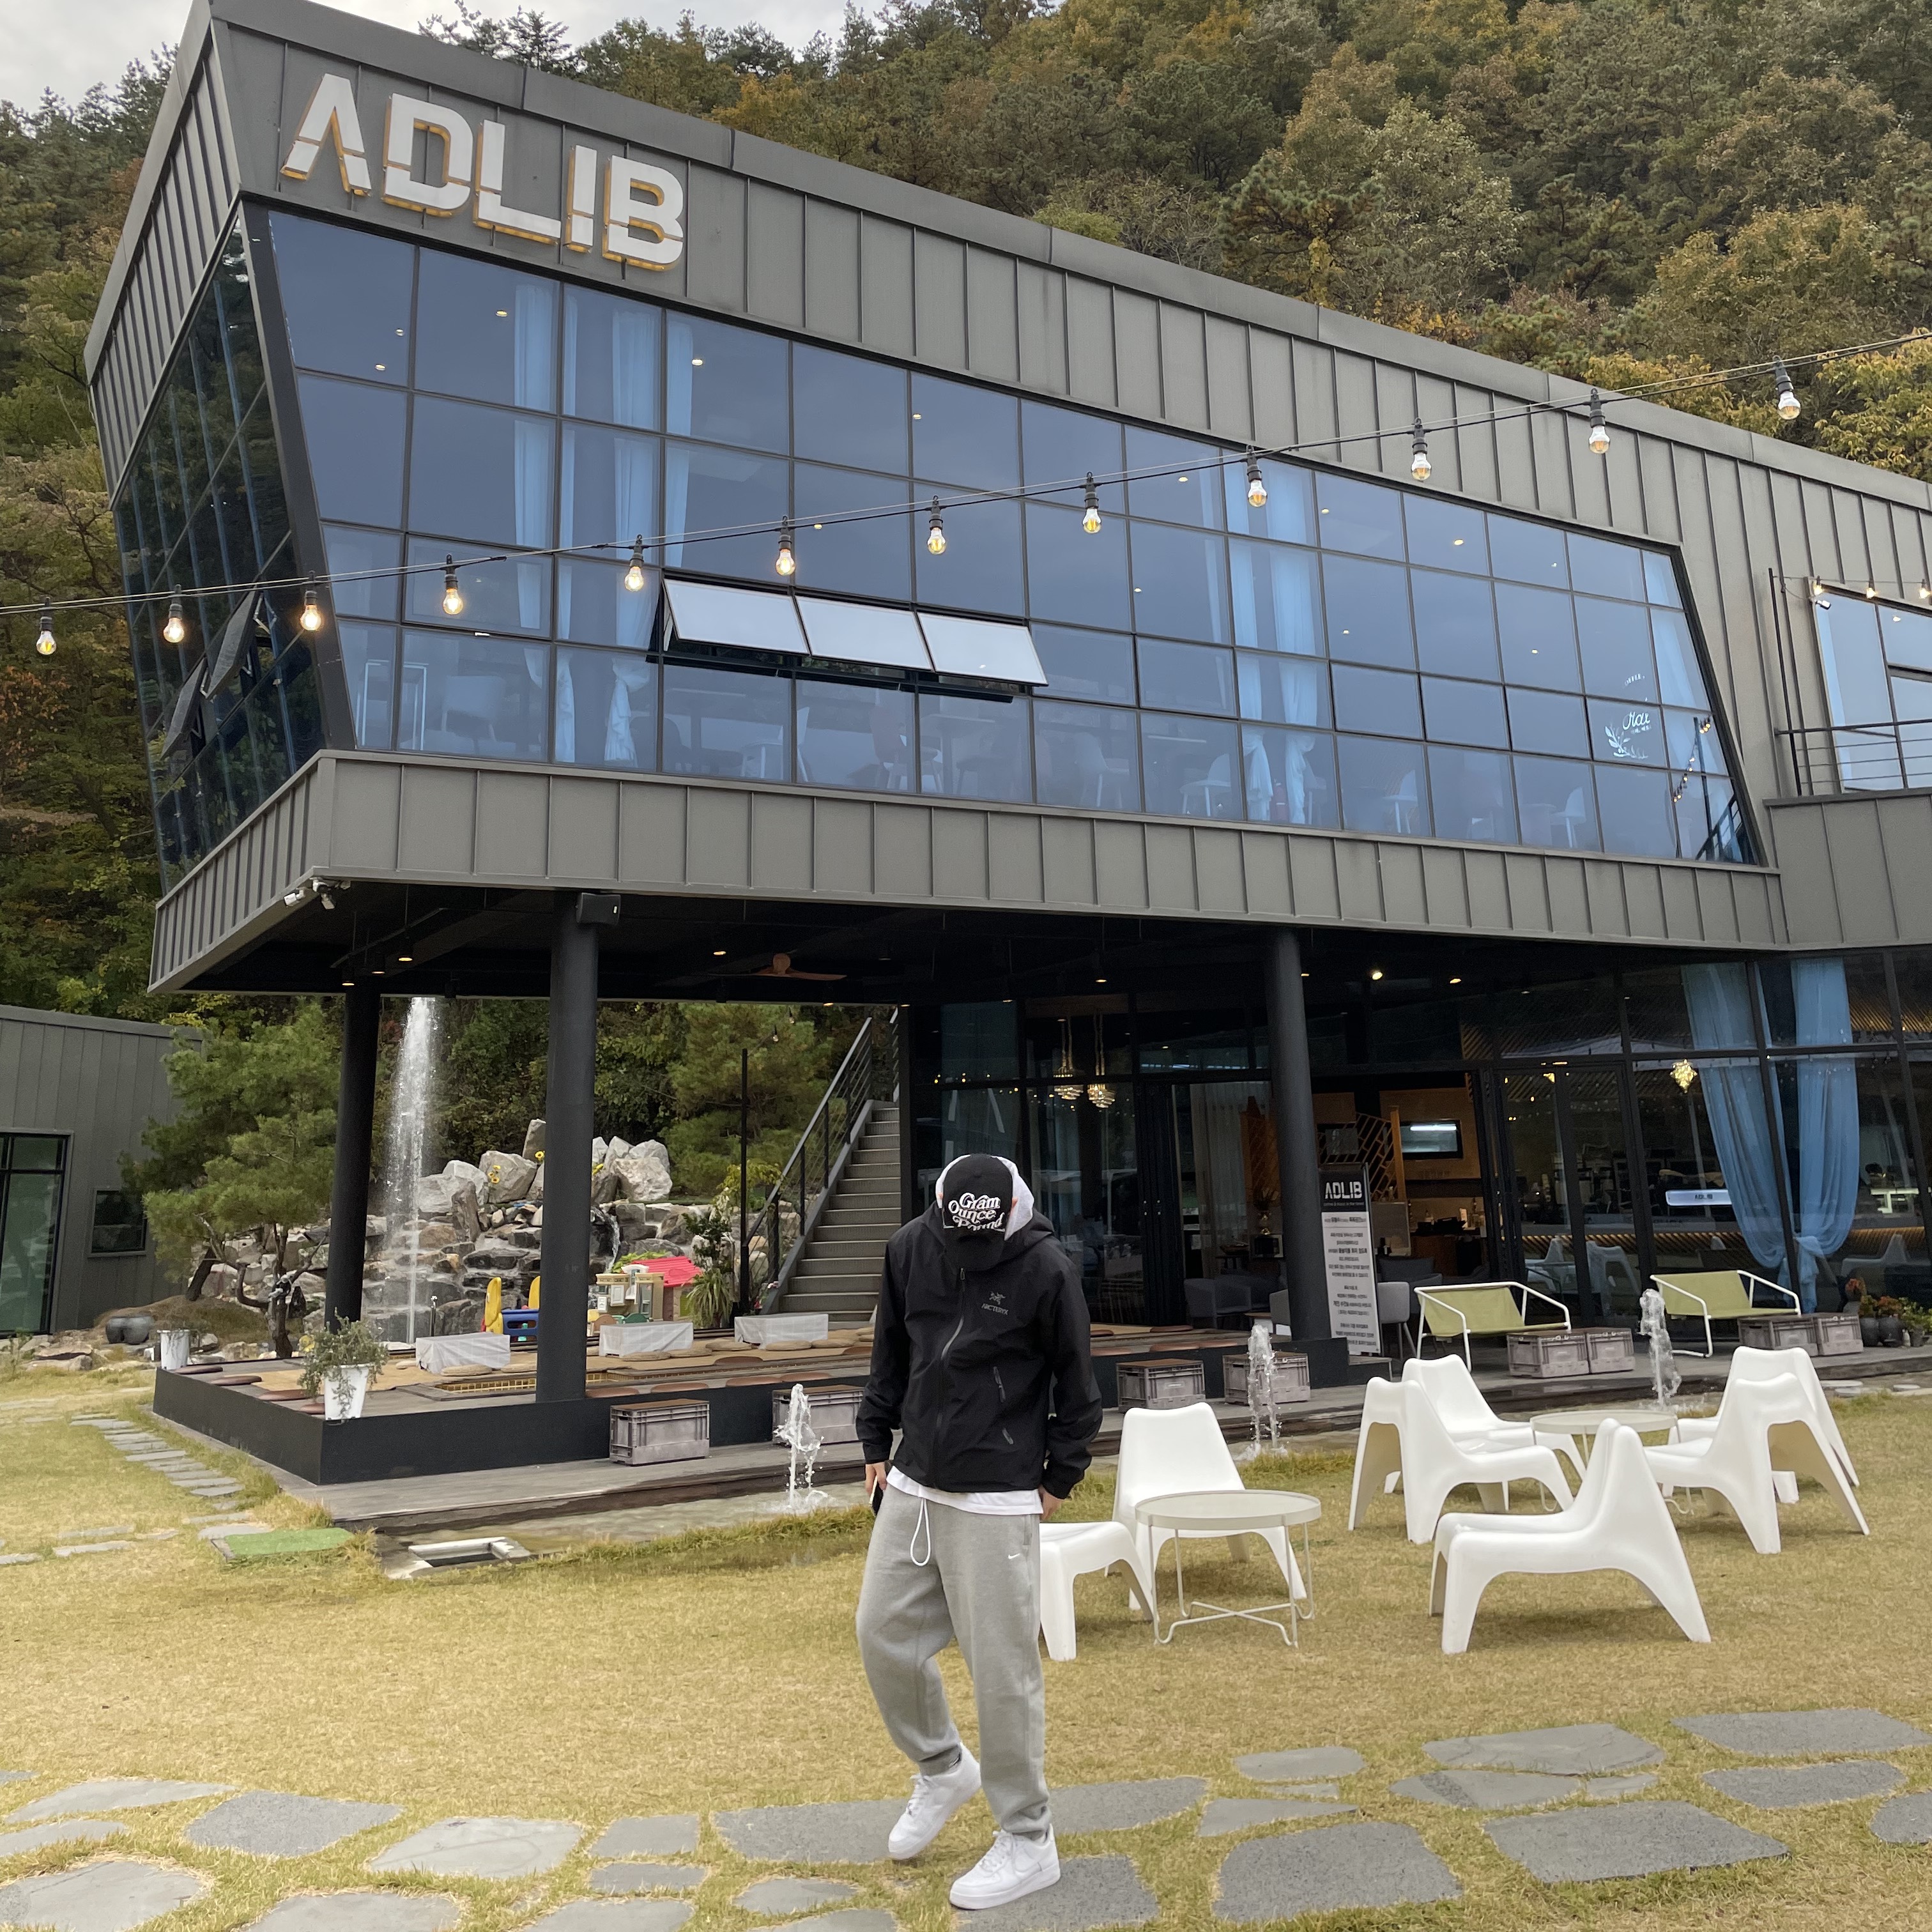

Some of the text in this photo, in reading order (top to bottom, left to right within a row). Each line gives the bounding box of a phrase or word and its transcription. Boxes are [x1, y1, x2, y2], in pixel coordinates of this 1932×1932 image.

[280, 73, 685, 271] ADLIB
[959, 1192, 1001, 1209] Gram
[1324, 1181, 1363, 1199] ADLIB
[948, 1200, 997, 1224] Ounce
